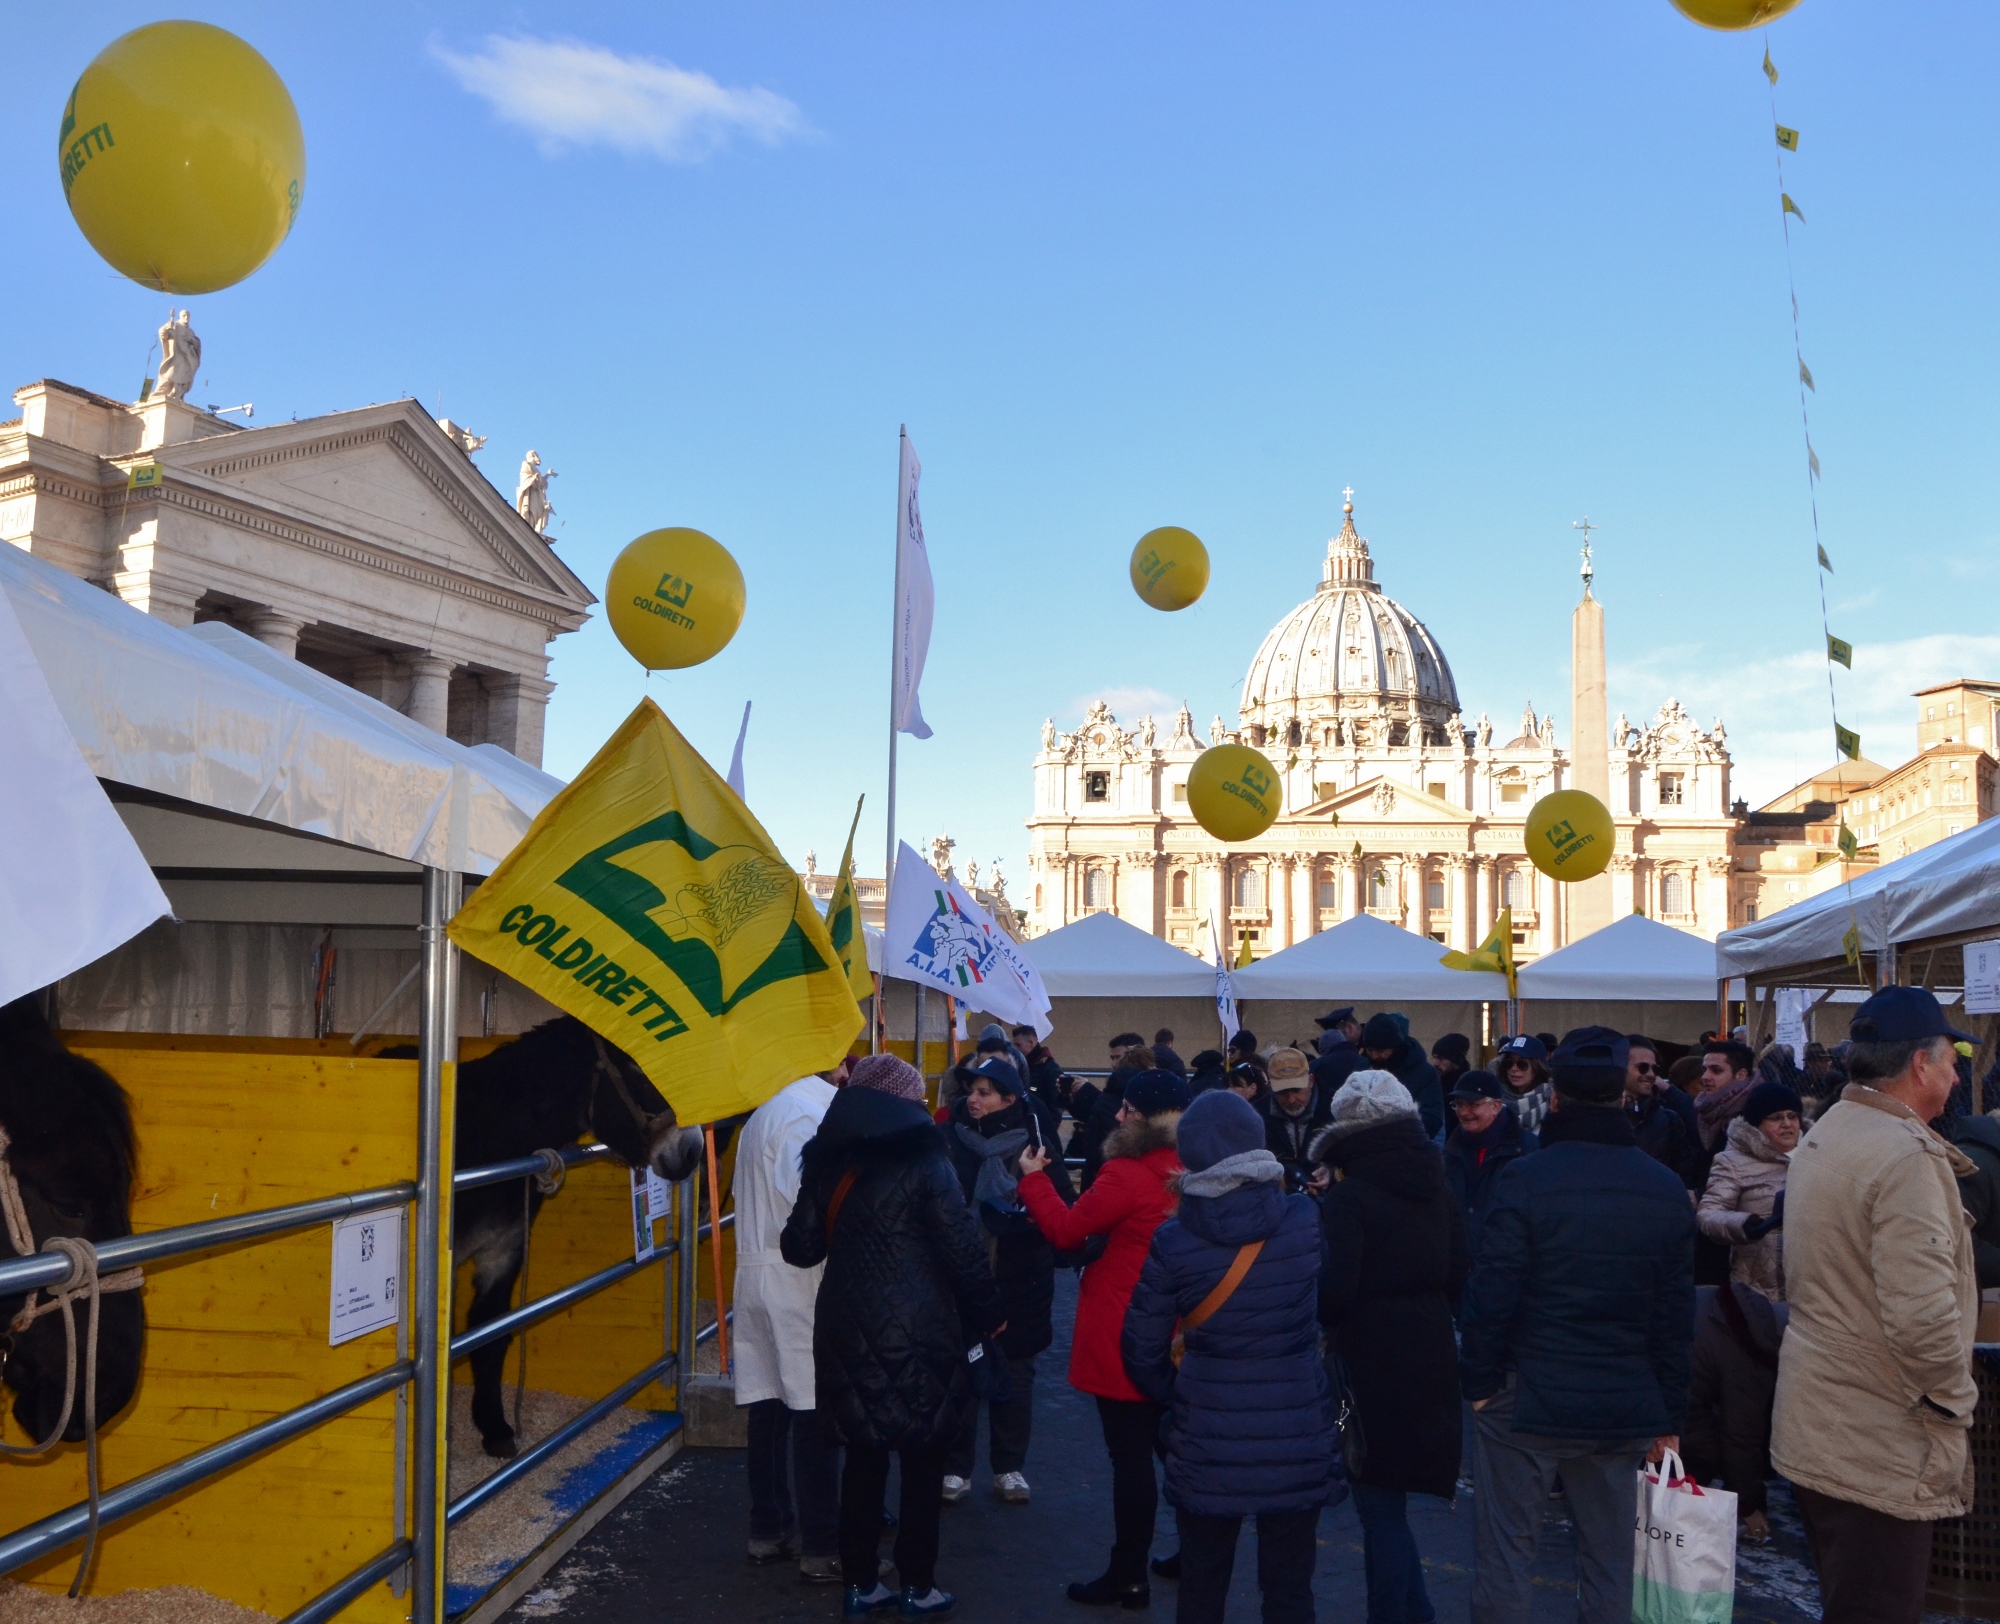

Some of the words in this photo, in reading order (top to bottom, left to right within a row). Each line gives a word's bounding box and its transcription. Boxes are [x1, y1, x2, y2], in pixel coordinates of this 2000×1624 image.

[631, 595, 696, 631] COLDIRETTI
[1222, 781, 1269, 818] COLDIRETTI
[1138, 830, 1150, 838] IN
[1553, 834, 1595, 866] COLDIRETTI
[499, 904, 690, 1042] COLDIRETTI
[905, 952, 955, 986] A.I.A.
[993, 934, 1031, 978] ITALIA
